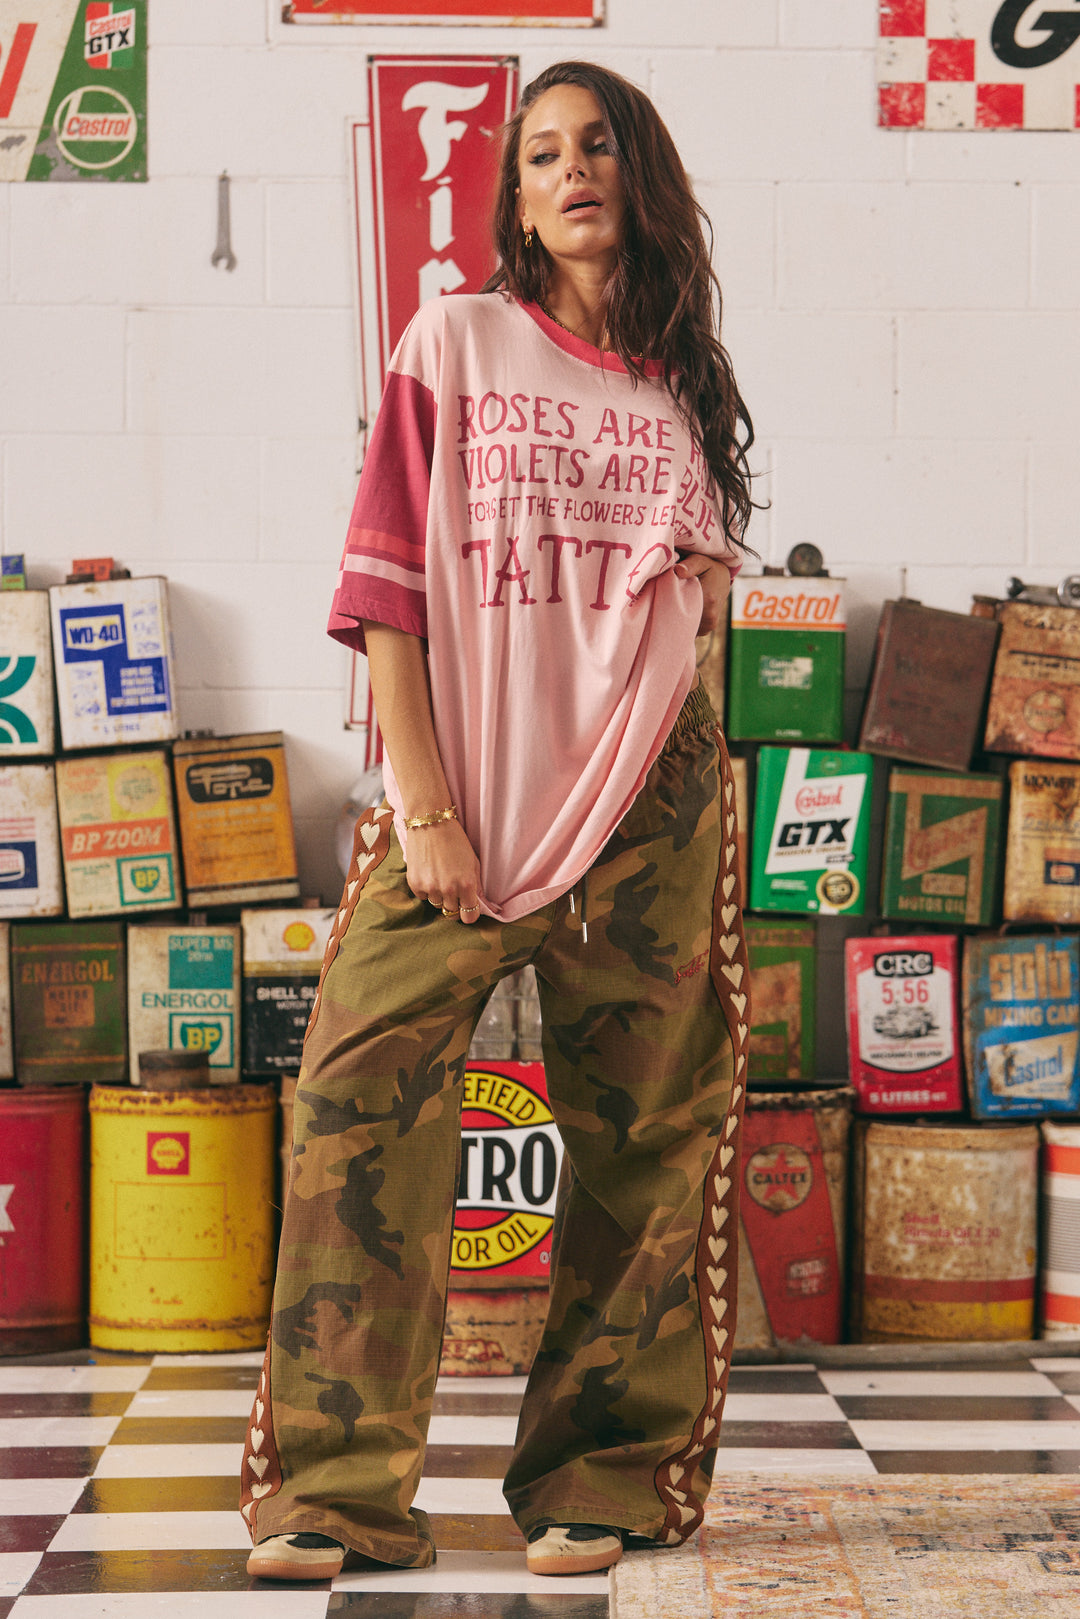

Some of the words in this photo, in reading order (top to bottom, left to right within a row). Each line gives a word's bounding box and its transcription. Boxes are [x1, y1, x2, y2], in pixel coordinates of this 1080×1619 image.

[89, 13, 132, 35] Castrol
[88, 29, 129, 55] GTX
[66, 116, 131, 137] Castrol
[457, 391, 579, 444] ROSES
[592, 408, 676, 452] ARE
[457, 443, 590, 490] VIOLETS
[598, 453, 672, 495] ARE
[467, 497, 521, 525] FORGET
[525, 495, 559, 517] THE
[563, 498, 647, 526] FLOWERS
[742, 590, 841, 621] Castrol
[69, 623, 119, 645] WD-40
[71, 831, 101, 854] BP
[102, 824, 164, 851] ZOOM
[778, 818, 852, 848] GTX
[133, 868, 159, 889] BP
[168, 936, 210, 951] SUPER
[21, 959, 115, 985] ENERGOL
[875, 953, 932, 975] CRC
[988, 943, 1072, 1001] solo
[141, 991, 234, 1009] ENERGOL
[256, 986, 299, 1001] SHELL
[984, 1005, 1044, 1027] MIXING
[186, 1026, 221, 1051] BP
[1004, 1045, 1063, 1087] Castrol
[881, 1090, 931, 1104] LITRES
[752, 1172, 807, 1185] CALTEX
[455, 1236, 491, 1262] OR
[497, 1219, 538, 1253] OIL
